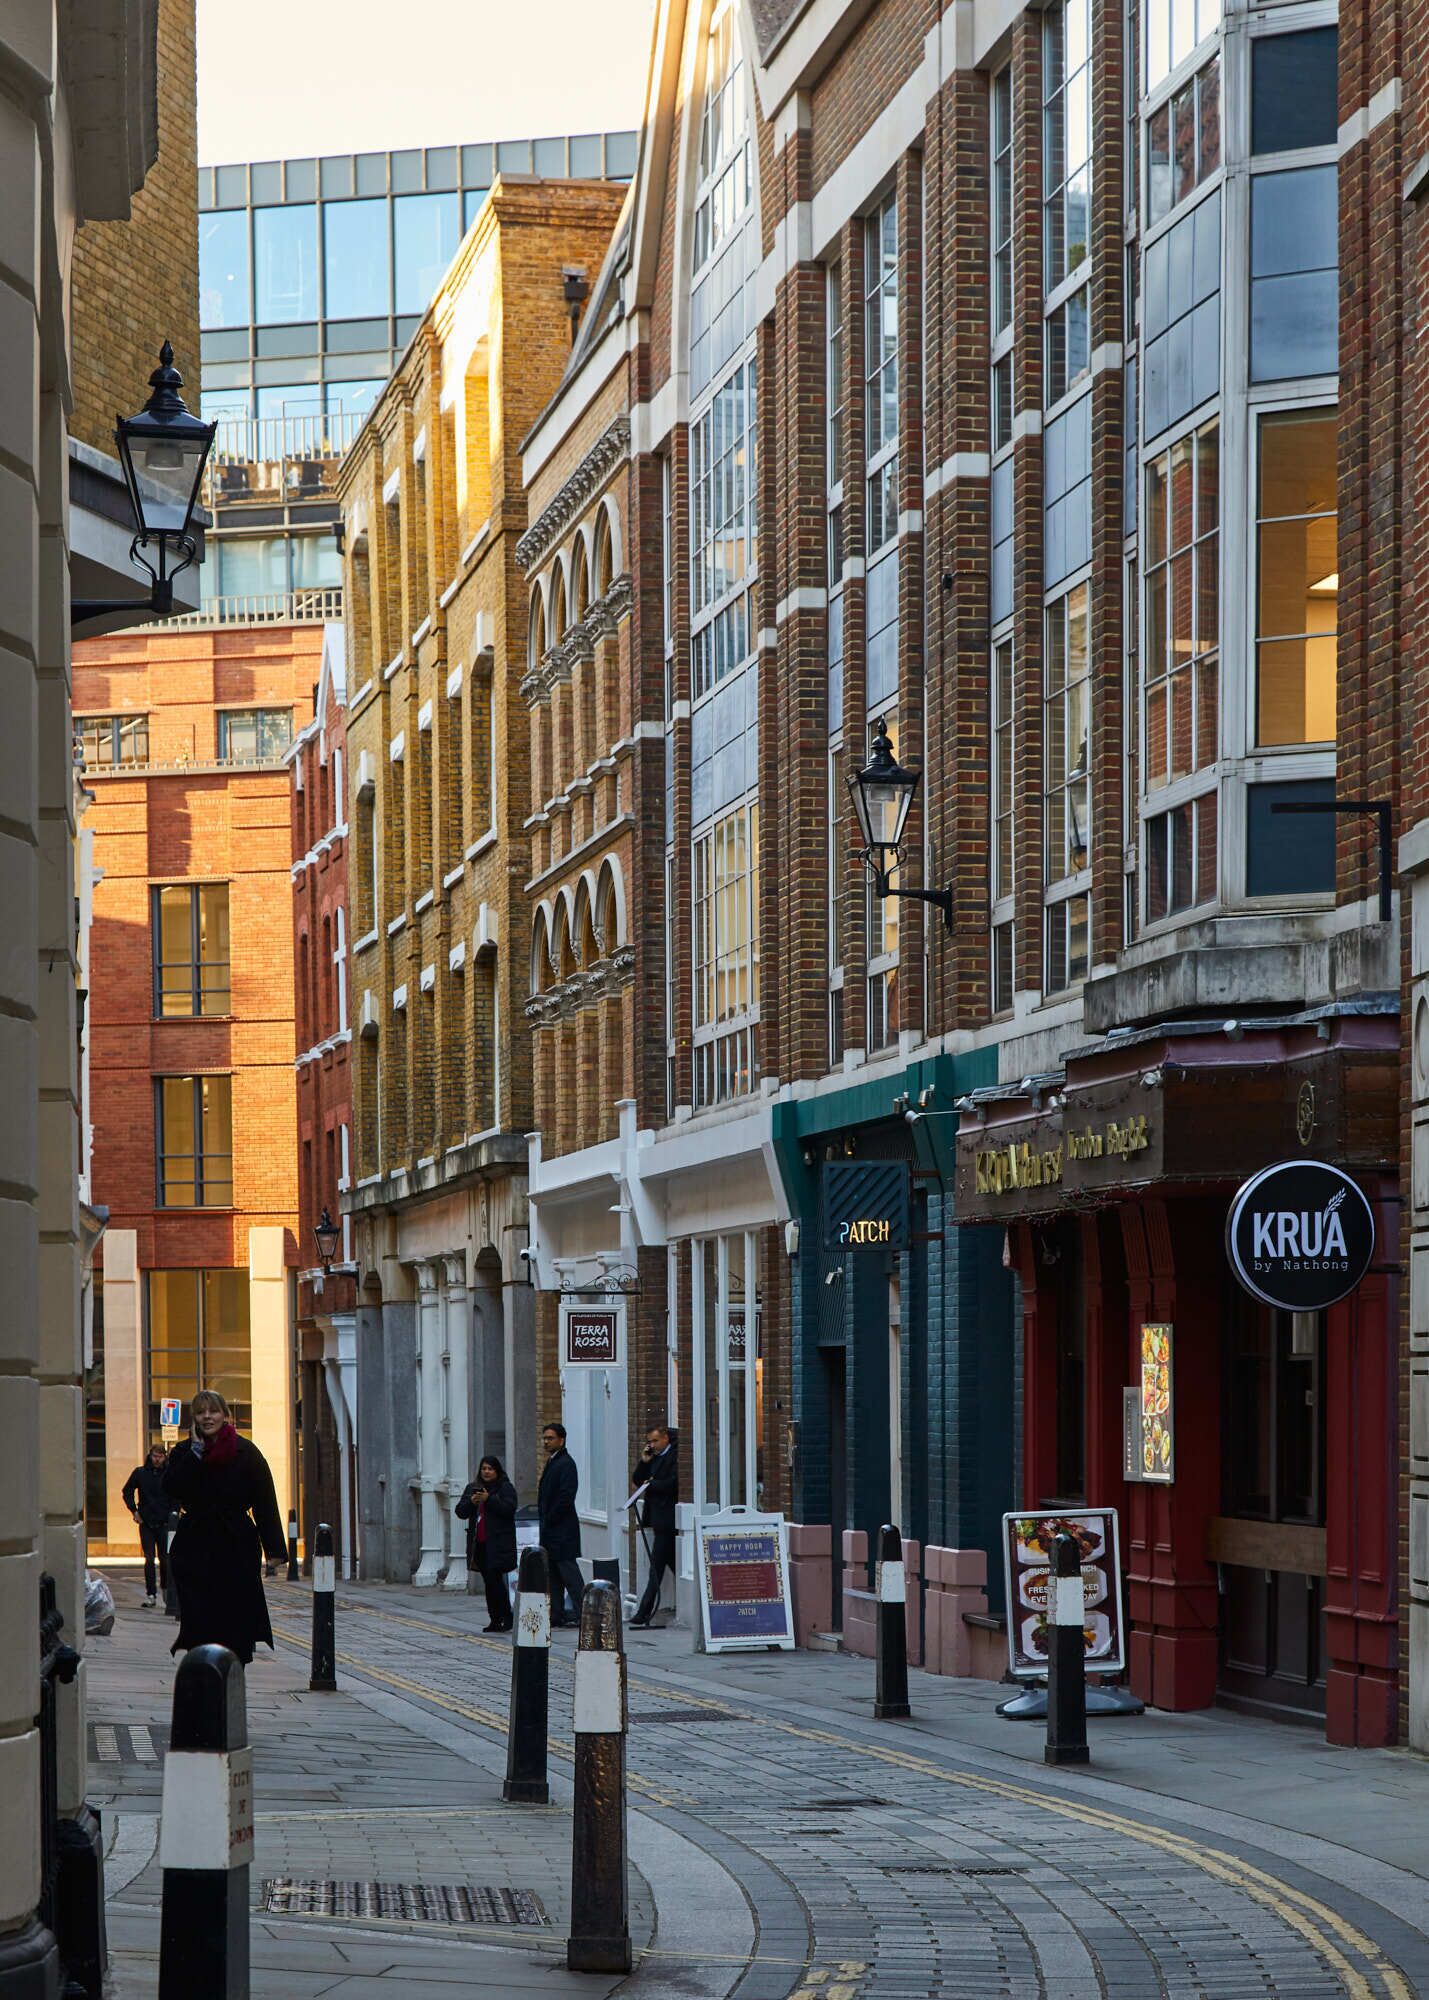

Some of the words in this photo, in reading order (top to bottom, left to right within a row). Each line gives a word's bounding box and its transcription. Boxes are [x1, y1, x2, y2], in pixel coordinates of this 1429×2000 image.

[840, 1220, 889, 1243] PATCH
[1254, 1260, 1272, 1273] by
[1283, 1259, 1349, 1272] Nathong
[574, 1325, 608, 1336] TERRA
[575, 1336, 609, 1348] ROSSA
[745, 1542, 762, 1550] HOUR
[1028, 1586, 1048, 1594] FRES
[1031, 1595, 1047, 1603] EVE
